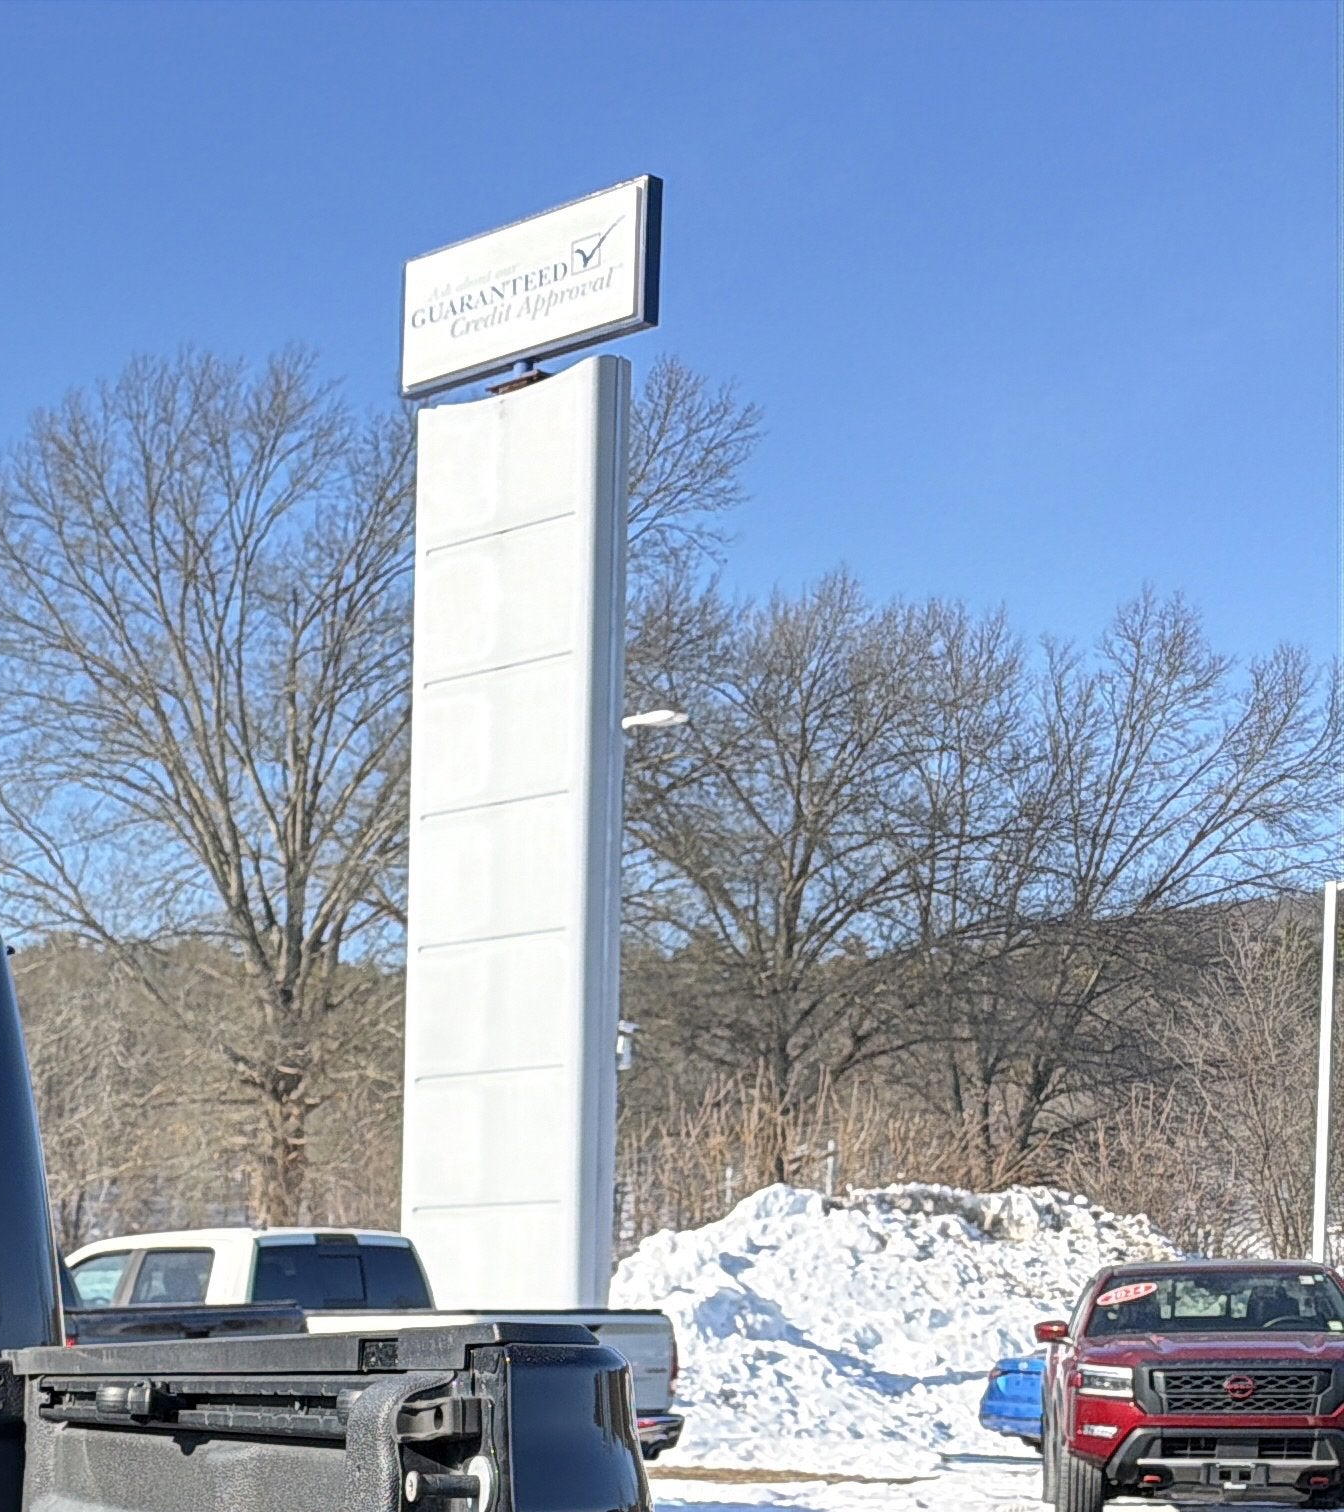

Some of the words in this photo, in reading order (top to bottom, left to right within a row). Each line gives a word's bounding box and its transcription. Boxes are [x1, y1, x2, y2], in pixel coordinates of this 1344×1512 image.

[411, 261, 568, 329] GUARANTEED
[450, 303, 512, 338] Credit
[516, 266, 615, 321] Approval
